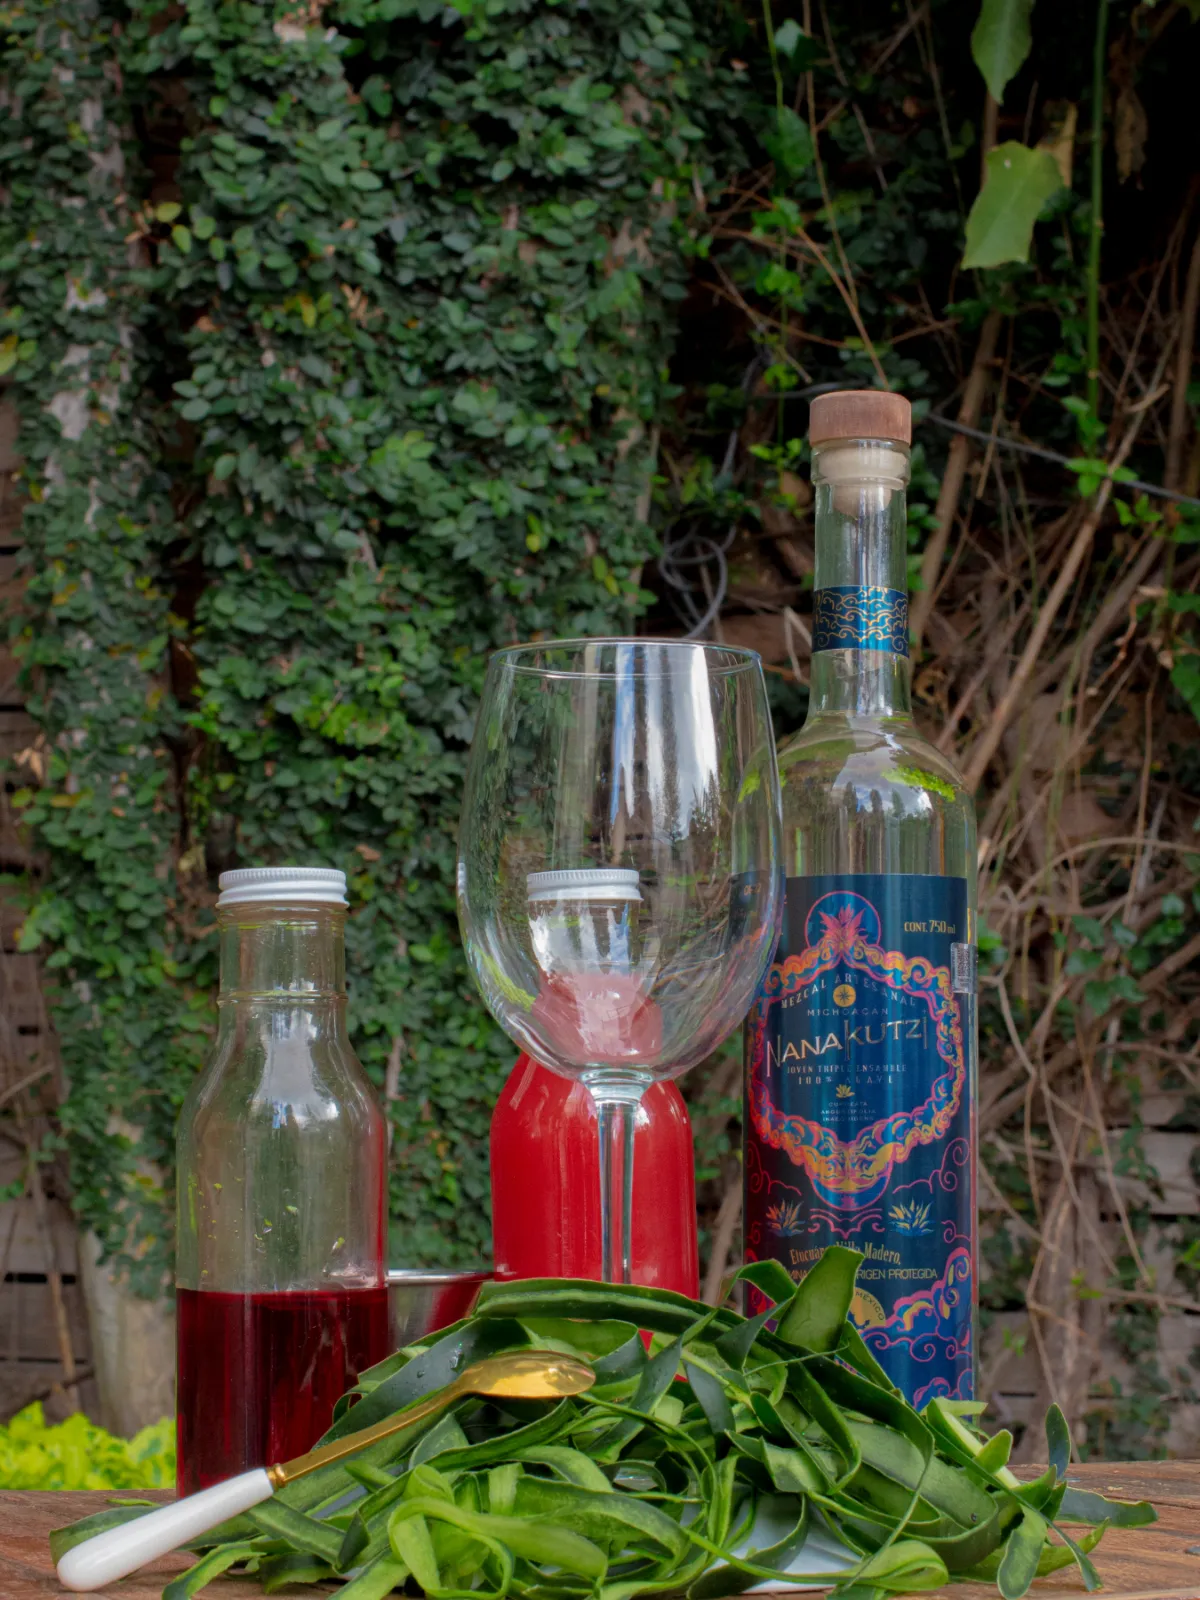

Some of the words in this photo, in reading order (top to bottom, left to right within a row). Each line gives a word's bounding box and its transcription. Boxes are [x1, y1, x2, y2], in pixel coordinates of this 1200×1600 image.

[904, 921, 928, 933] CONT.
[929, 919, 947, 933] 750
[947, 923, 956, 934] ml
[781, 979, 827, 1009] MEZCAL
[834, 973, 916, 1006] ARTESANAL
[787, 1064, 813, 1074] JOVEN
[818, 1063, 852, 1073] TRIPLE
[856, 1063, 907, 1073] ENSAMBLE
[798, 1075, 833, 1085] 100%
[789, 1245, 826, 1265] Etucuár
[856, 1268, 886, 1280] RIGEN
[888, 1268, 938, 1280] PROTEGIDA
